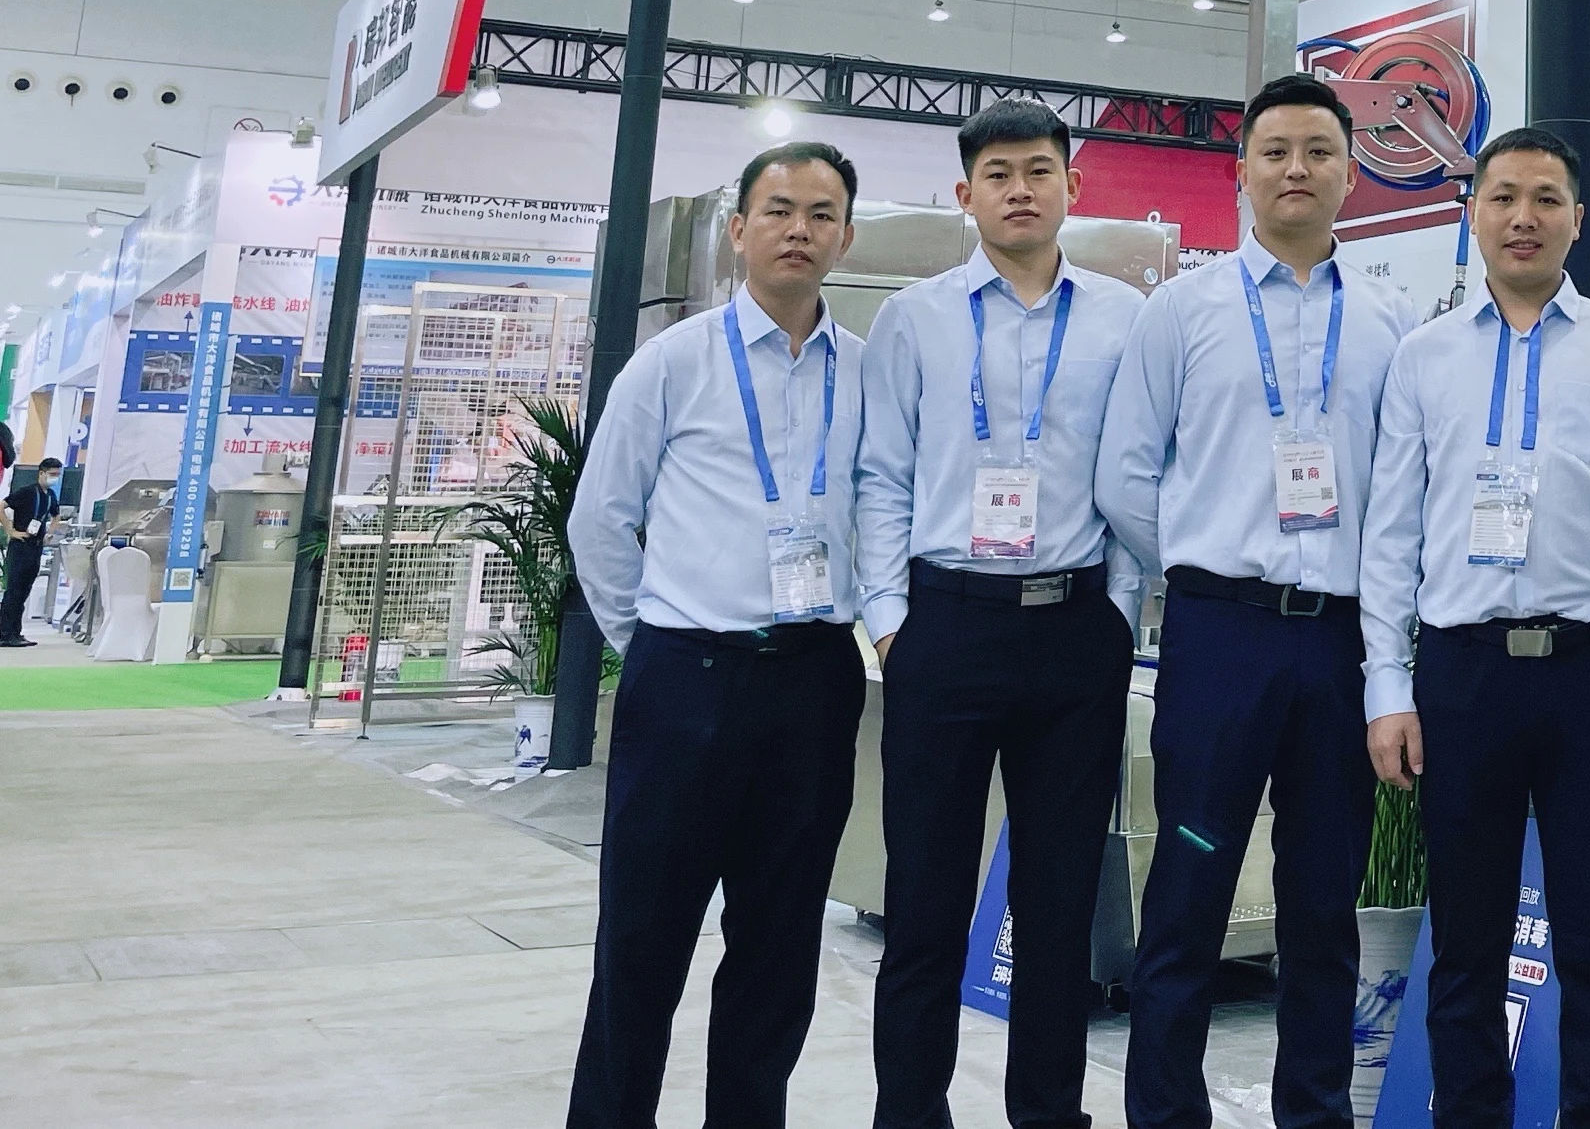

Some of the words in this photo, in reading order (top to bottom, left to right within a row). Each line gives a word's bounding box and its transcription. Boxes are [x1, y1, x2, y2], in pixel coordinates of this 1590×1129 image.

[420, 204, 485, 220] Zhucheng
[487, 208, 547, 224] Shenlong
[1291, 467, 1320, 481] 展商
[990, 493, 1021, 507] 展商
[1513, 914, 1550, 949] 消毒
